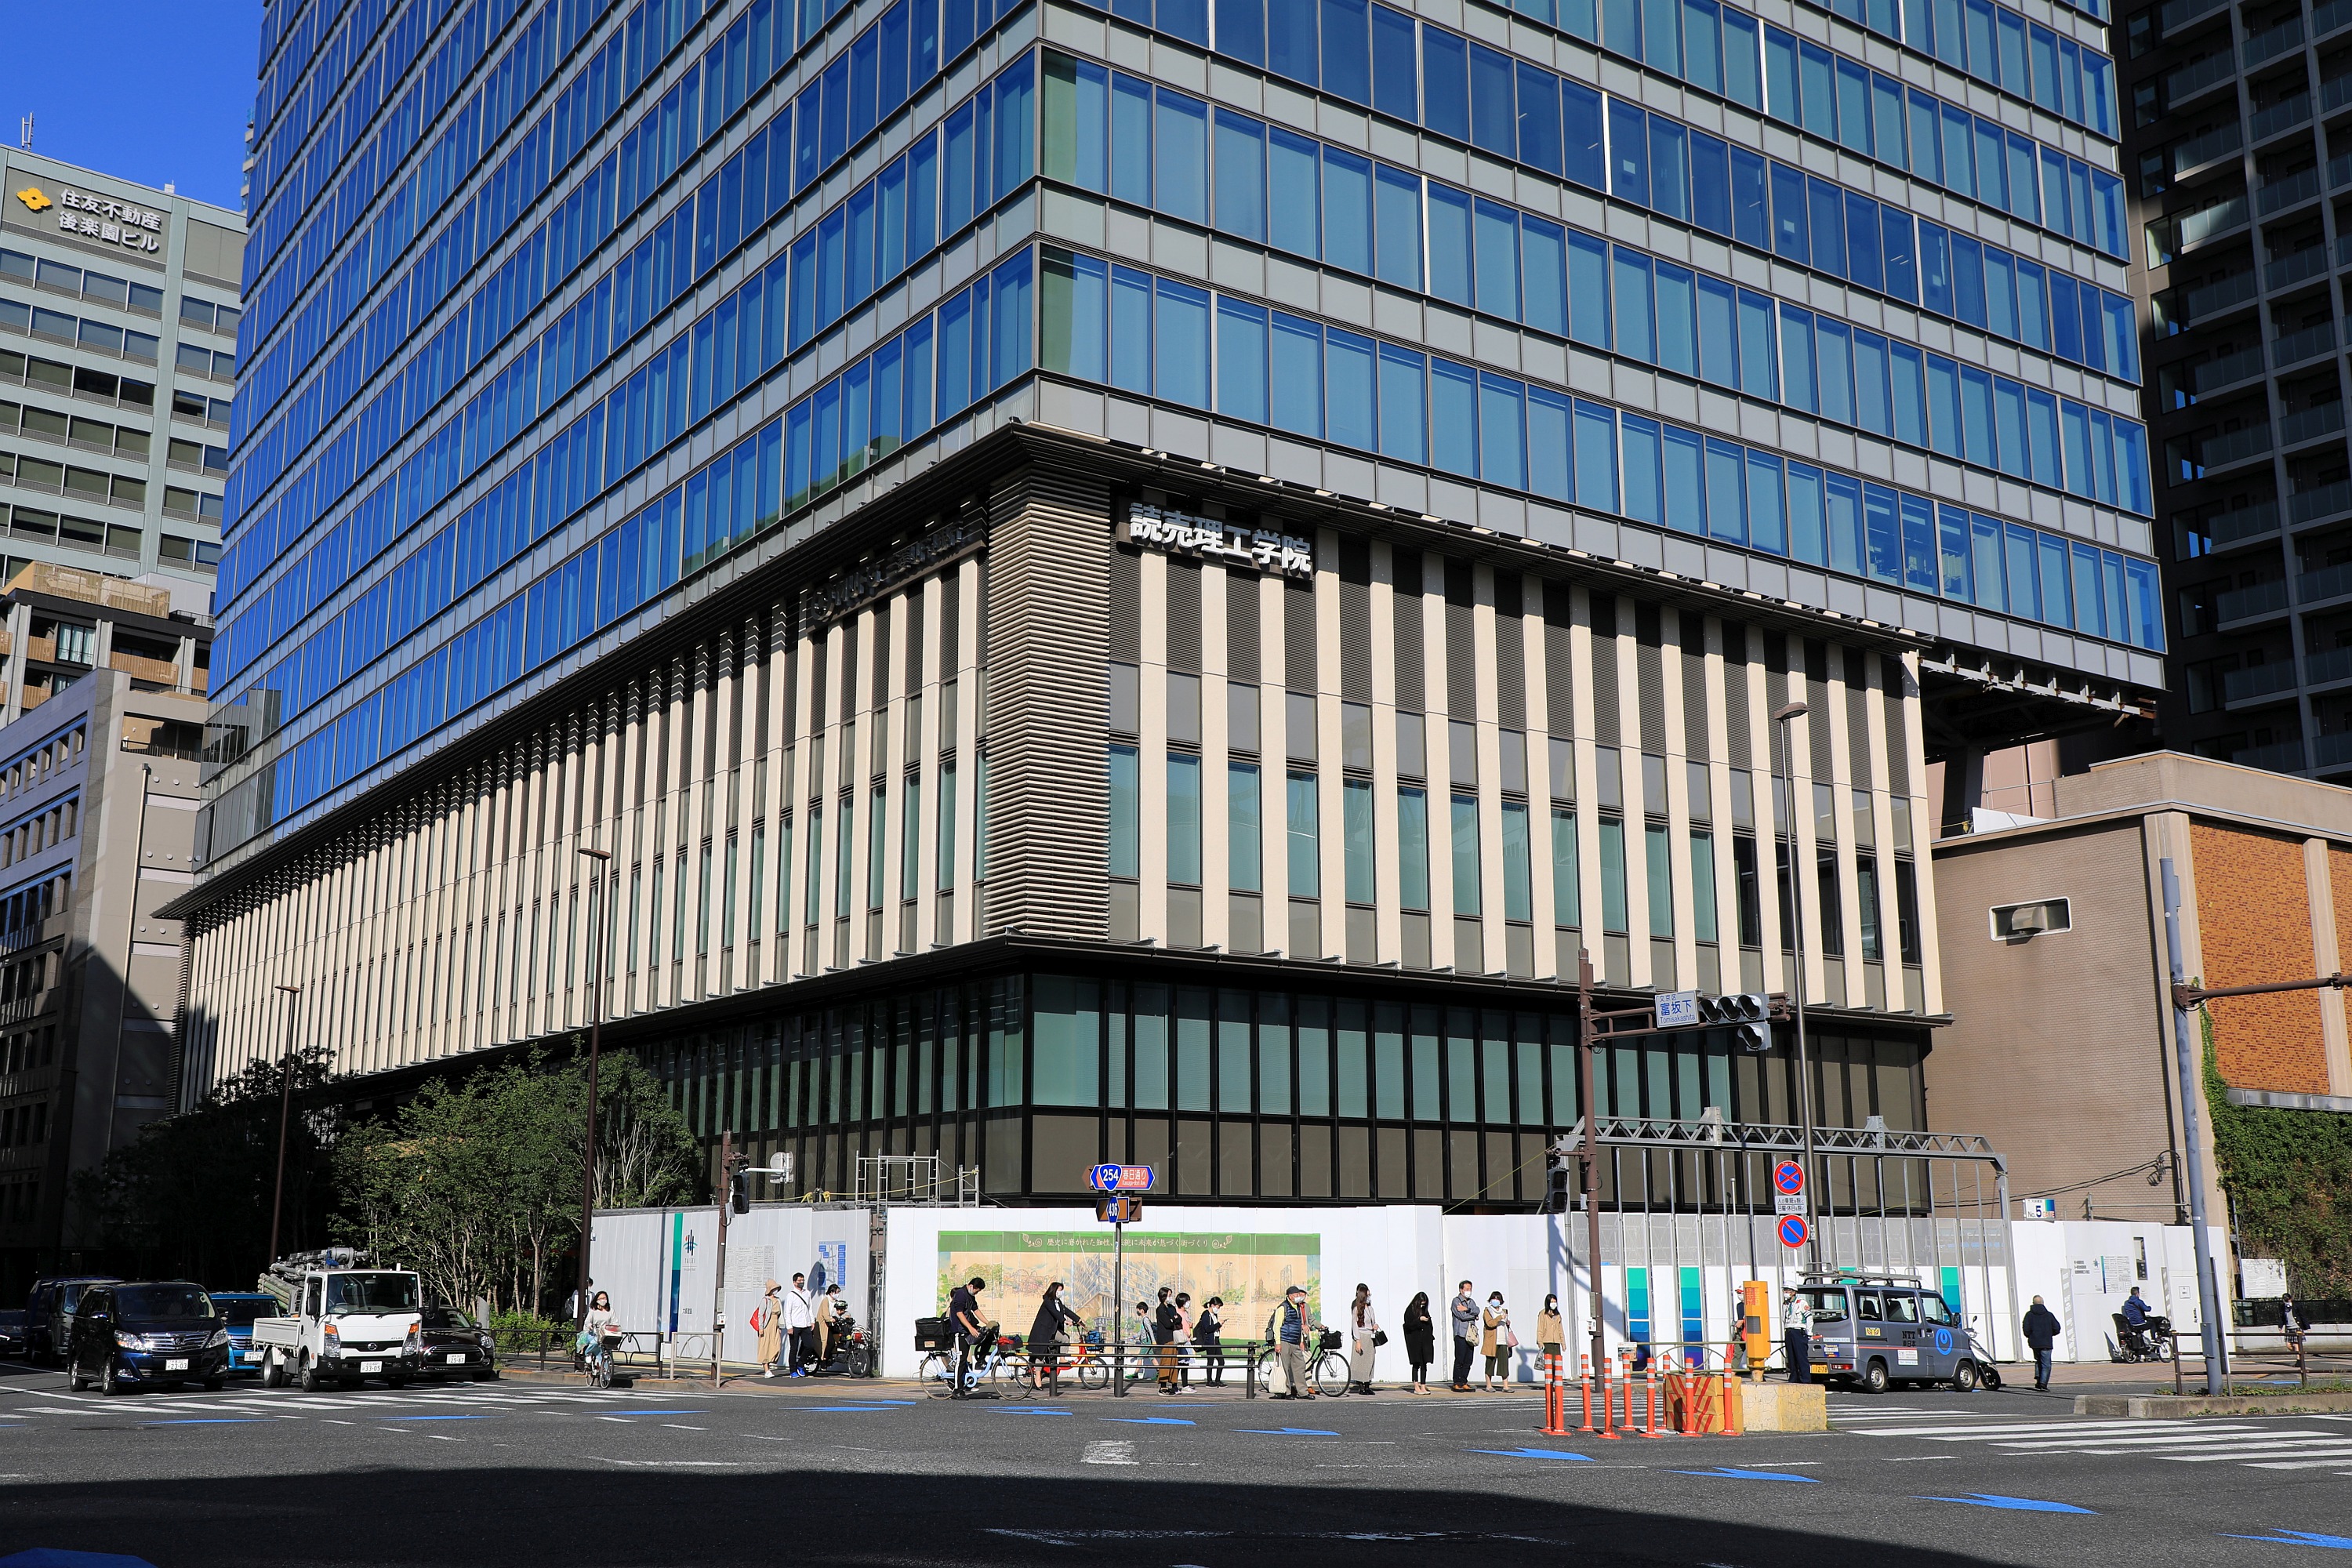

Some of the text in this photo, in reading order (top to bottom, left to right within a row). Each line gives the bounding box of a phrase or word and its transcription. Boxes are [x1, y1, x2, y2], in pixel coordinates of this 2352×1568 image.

[60, 188, 162, 231] 住友不動産
[58, 210, 159, 252] 後楽園ビル
[1129, 503, 1312, 573] 読売理工学院
[1660, 1000, 1692, 1016] 富坂下
[1660, 1014, 1696, 1024] Tomisakashita
[1103, 1169, 1119, 1181] 254
[1123, 1169, 1146, 1180] 春日通り
[1109, 1203, 1118, 1217] 436
[2036, 1205, 2042, 1218] 5
[1902, 1330, 1916, 1339] NTT
